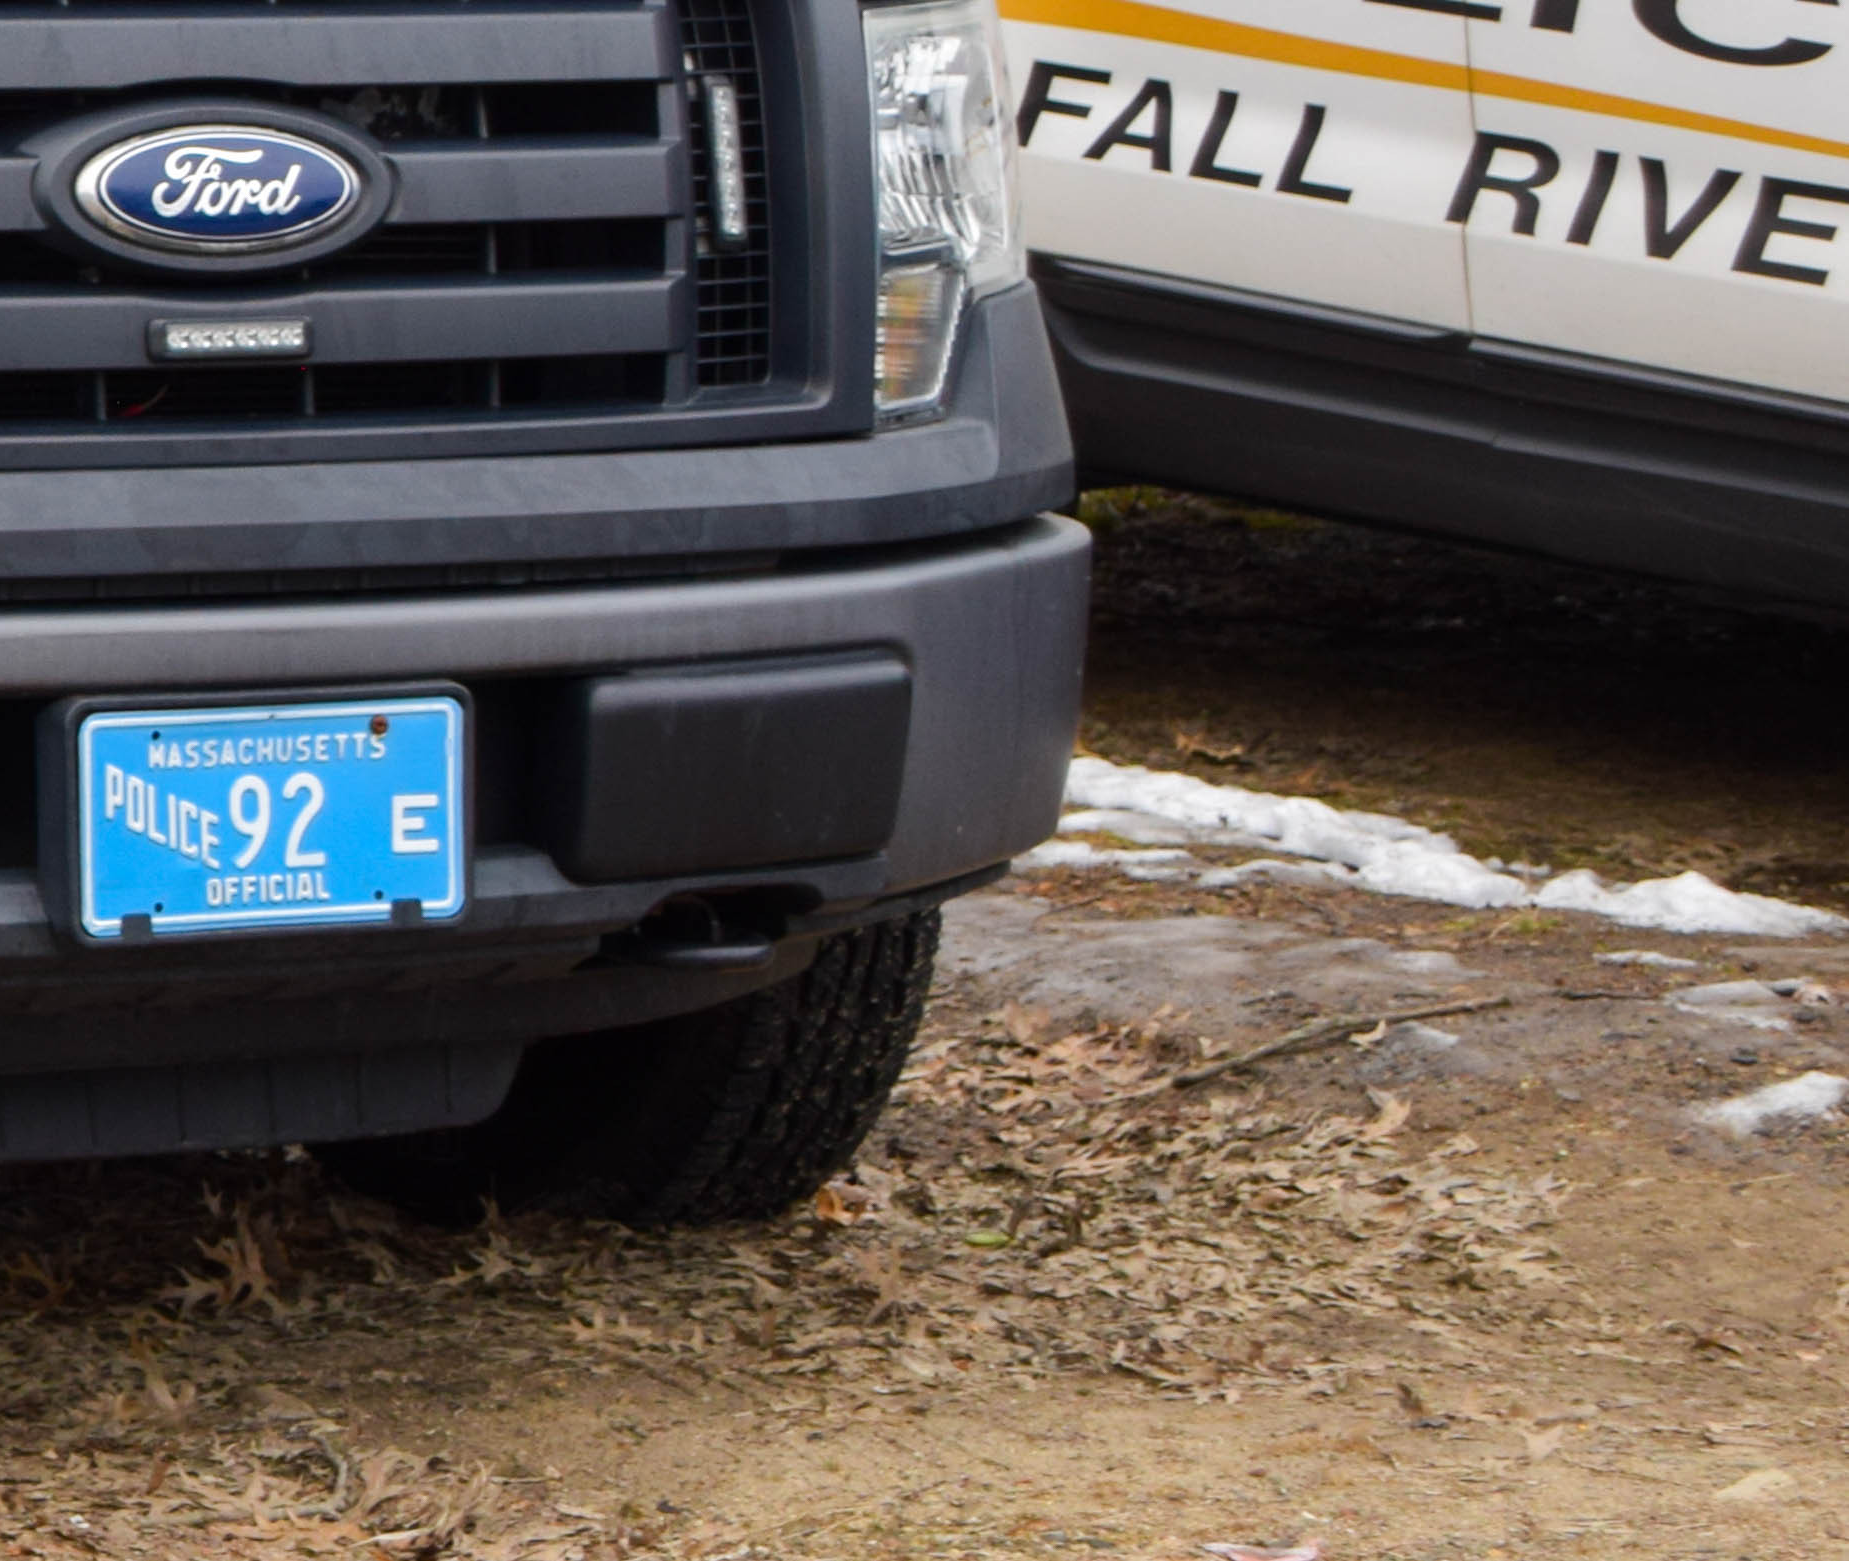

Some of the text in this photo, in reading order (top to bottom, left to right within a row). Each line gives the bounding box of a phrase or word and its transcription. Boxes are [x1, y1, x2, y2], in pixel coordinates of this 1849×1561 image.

[1018, 60, 1353, 206] FALL
[152, 146, 302, 218] Ford
[148, 732, 388, 770] MASSACHUSETTS
[104, 762, 222, 870] POLICE
[228, 772, 440, 870] 92 E
[206, 873, 332, 907] OFFICIAL
